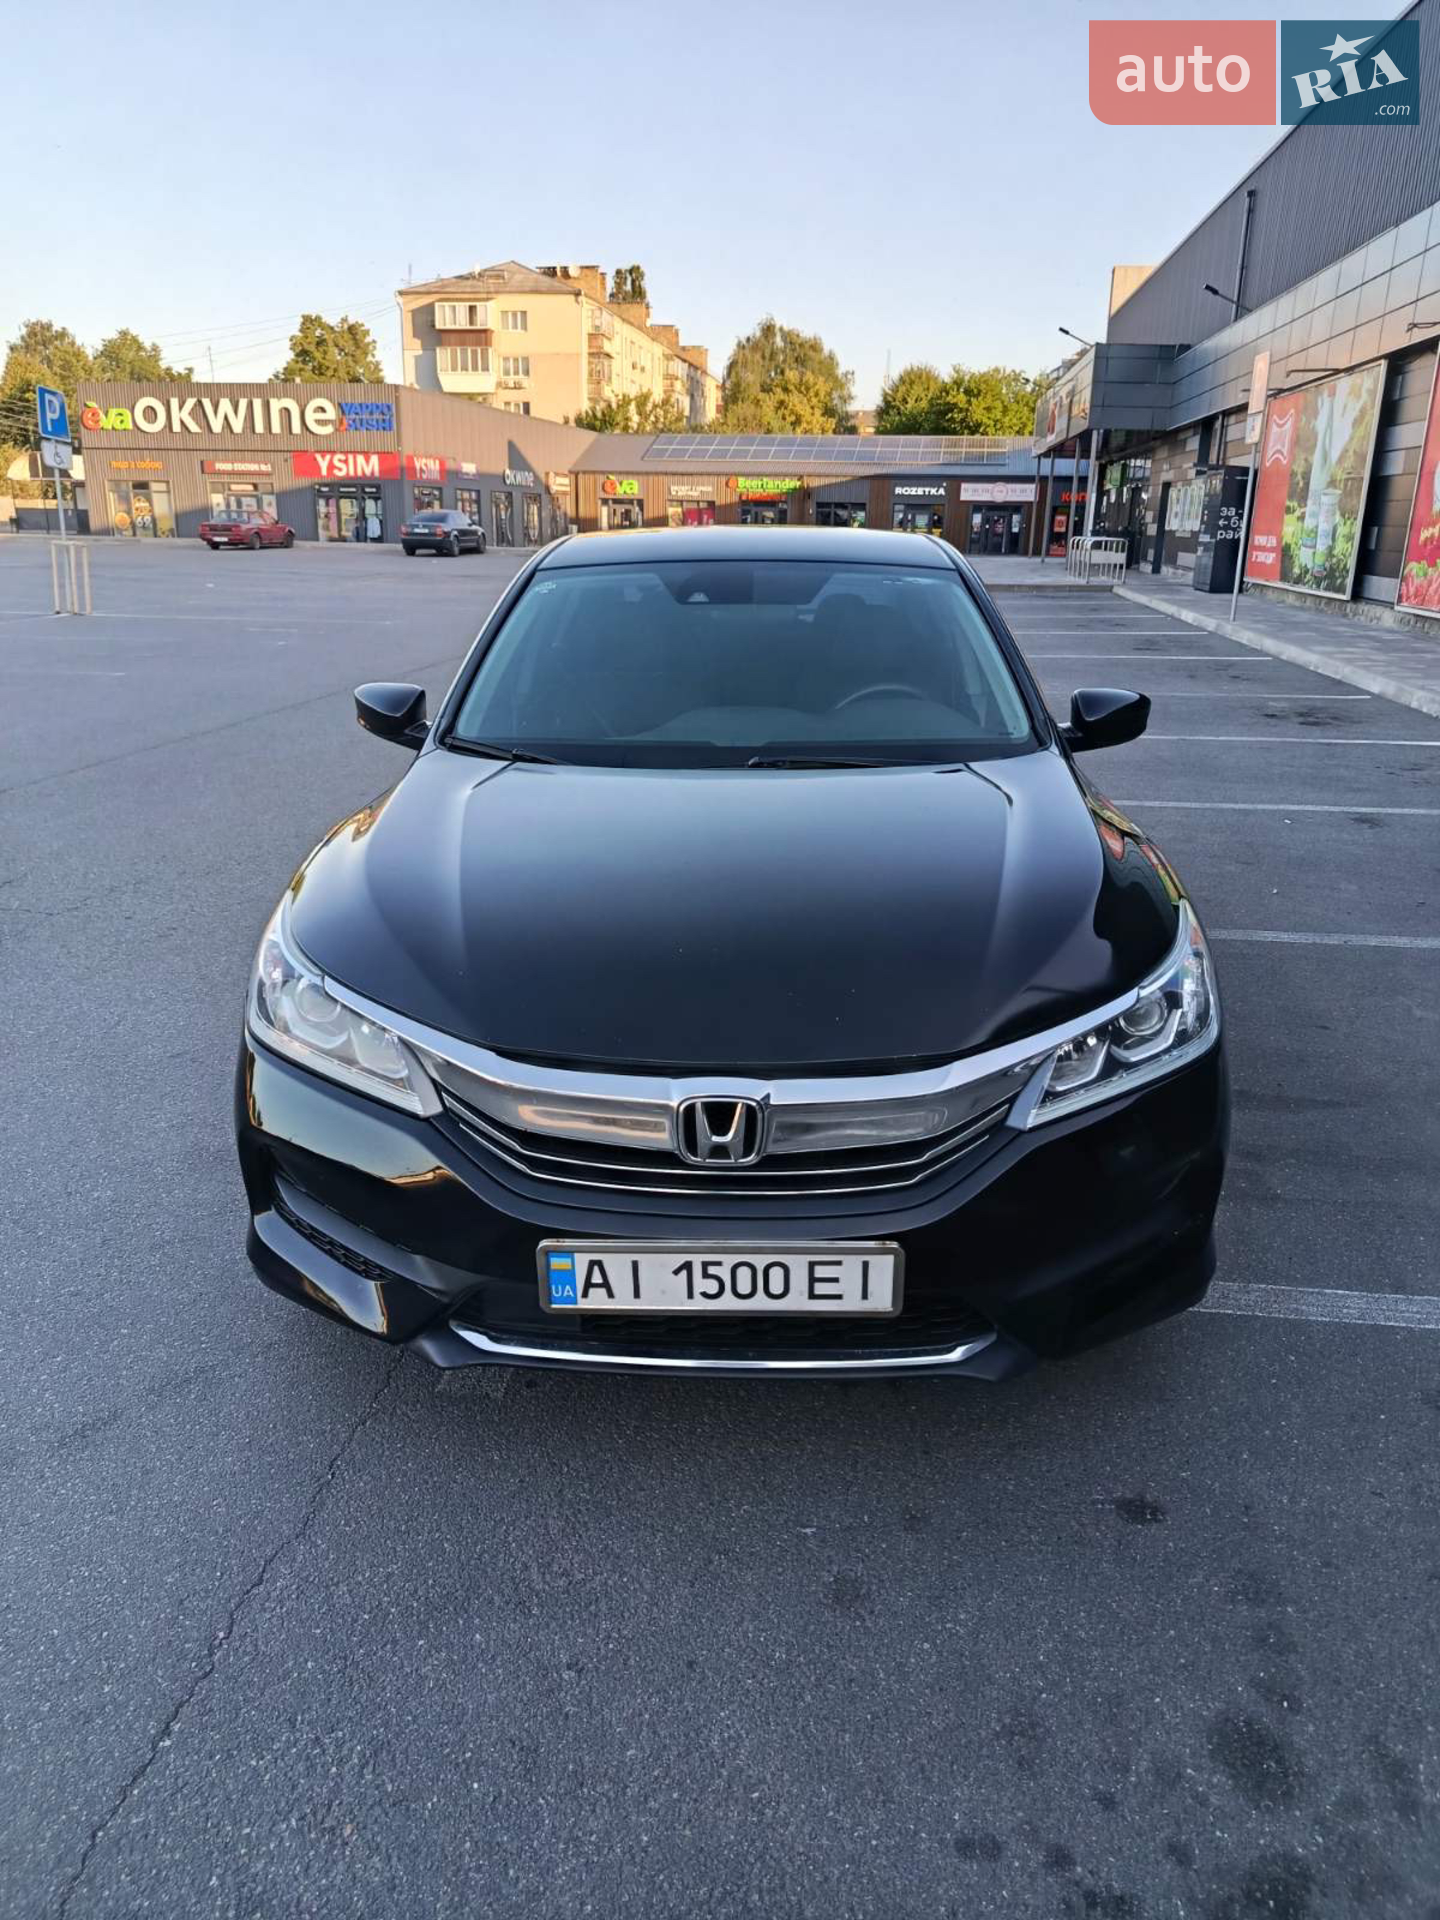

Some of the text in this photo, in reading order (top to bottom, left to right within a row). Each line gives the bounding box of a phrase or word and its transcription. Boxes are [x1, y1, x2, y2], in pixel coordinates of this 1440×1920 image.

[44, 392, 60, 432] P
[314, 453, 380, 477] YSIM
[413, 456, 440, 480] YSIM
[738, 477, 801, 490] Beerlander
[894, 486, 946, 496] ROZETKA
[551, 1284, 575, 1298] UA
[671, 1260, 791, 1300] 1500
